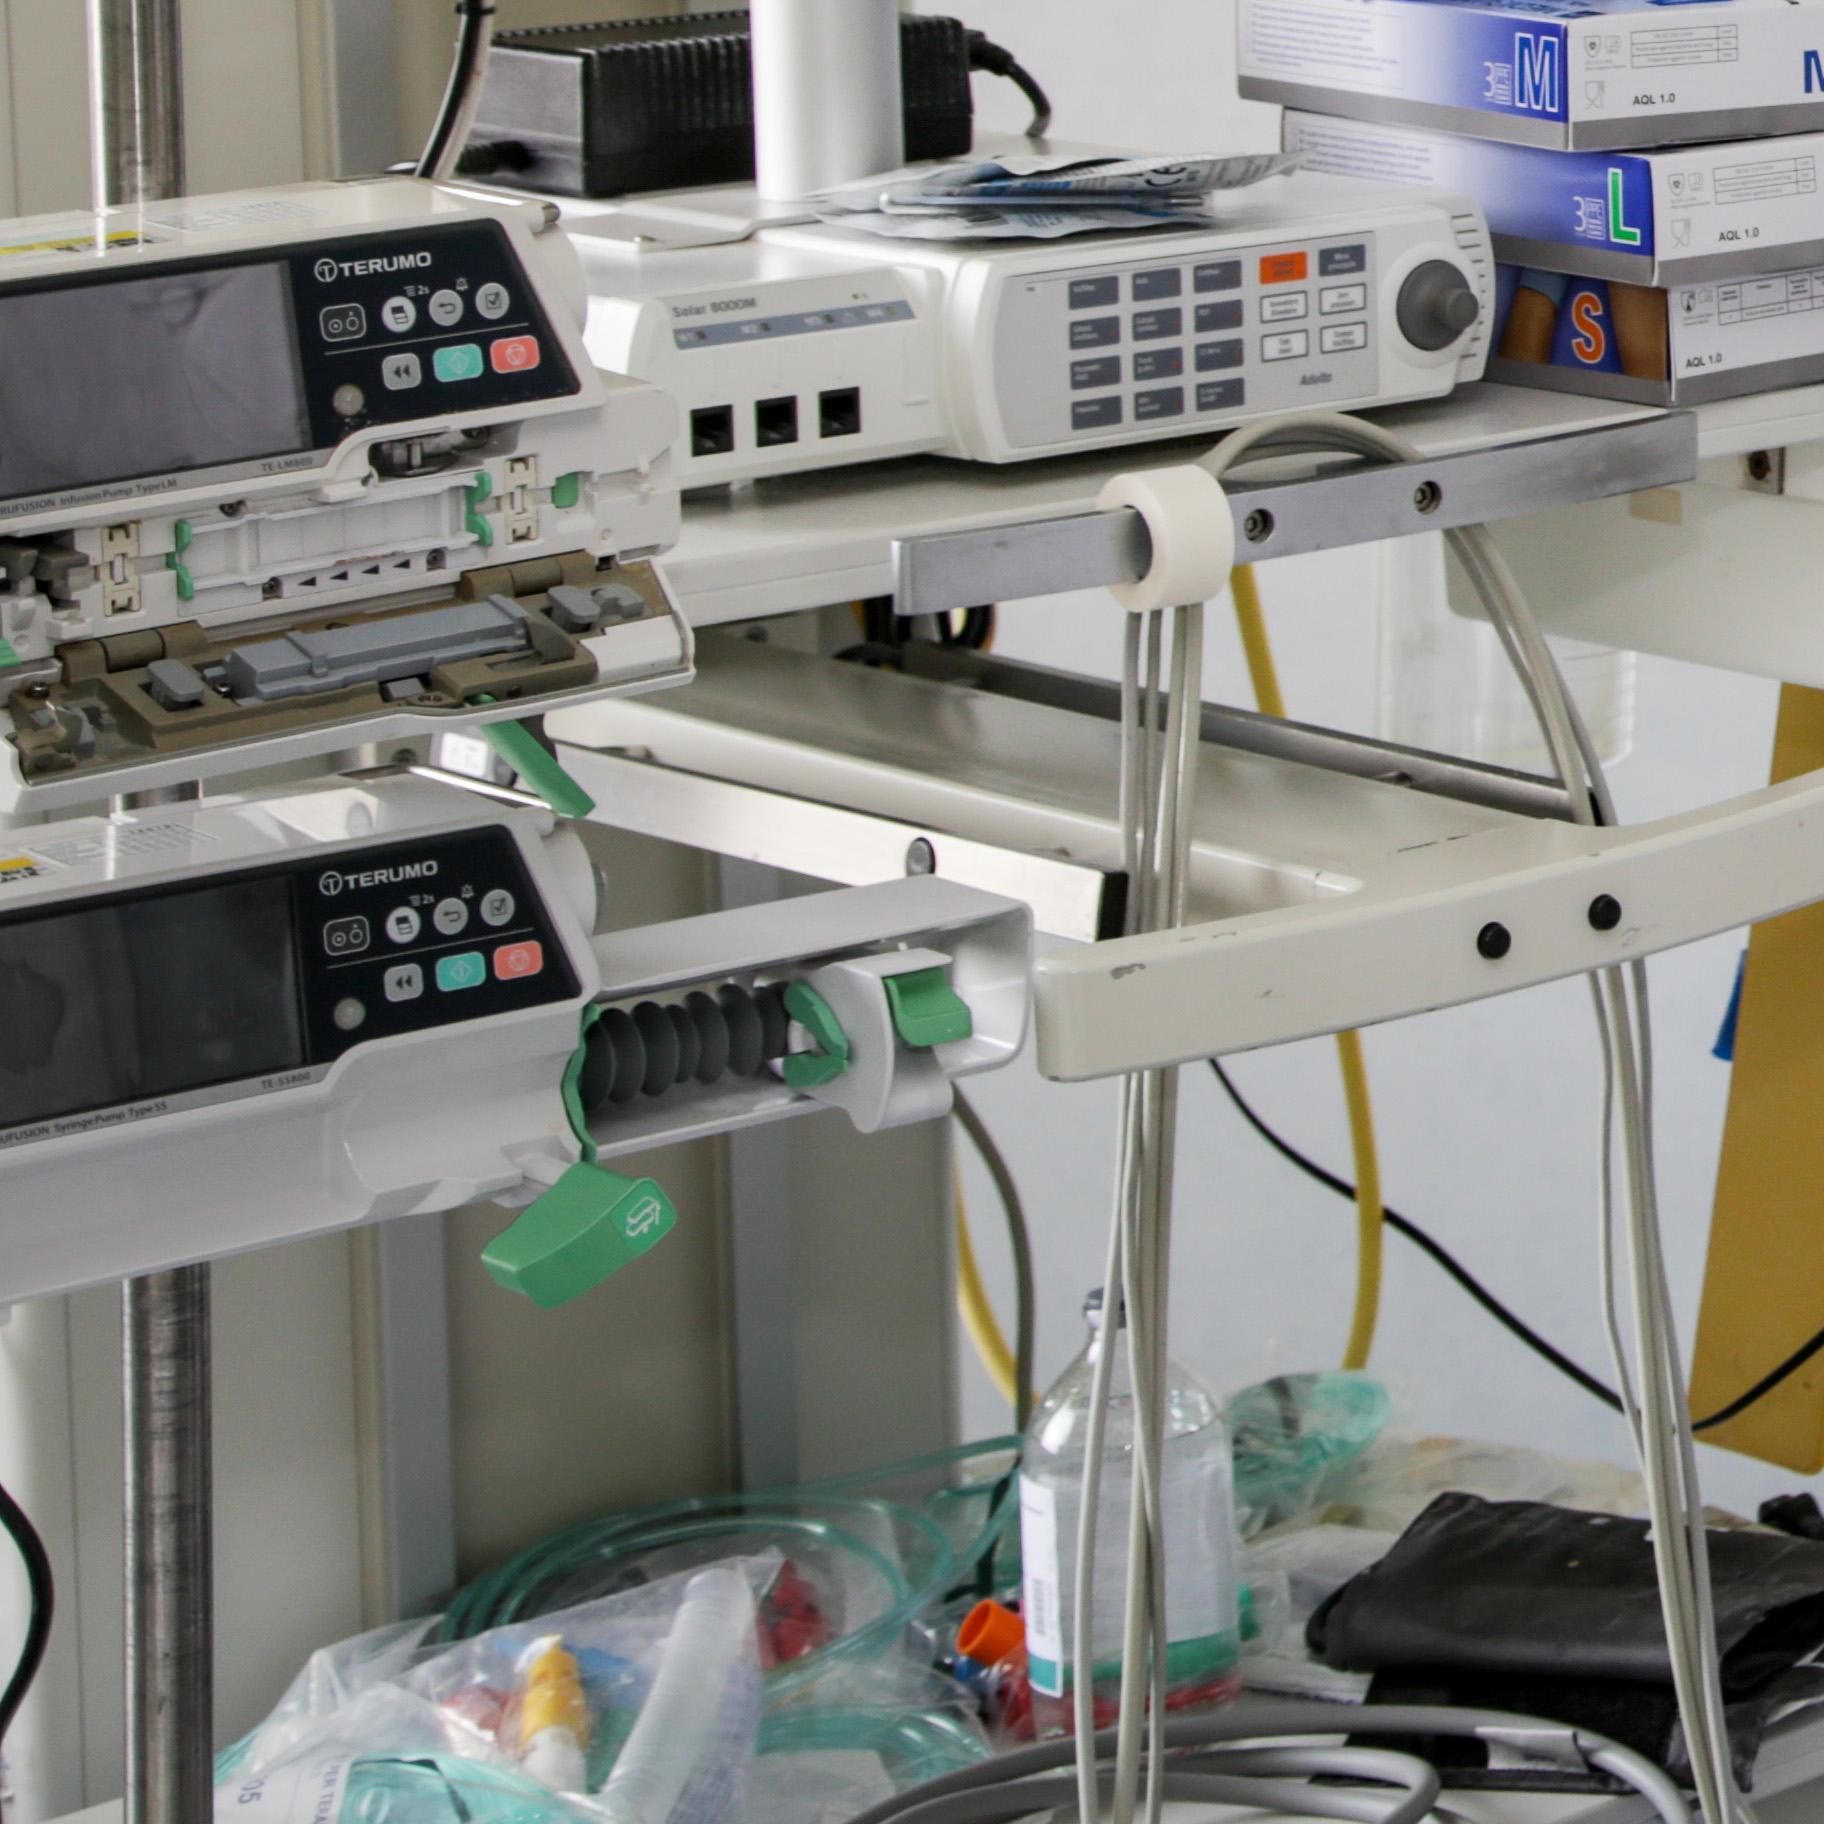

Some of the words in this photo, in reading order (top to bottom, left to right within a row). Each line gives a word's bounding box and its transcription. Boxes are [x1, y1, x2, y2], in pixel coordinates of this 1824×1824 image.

[1515, 32, 1560, 113] M
[1632, 94, 1657, 106] AQL
[1659, 93, 1676, 104] 1.0
[1607, 167, 1641, 247] L
[1718, 228, 1741, 242] AQL
[1744, 227, 1760, 240] 1.0
[339, 252, 432, 278] TERUMO
[417, 284, 430, 295] 2s
[672, 305, 707, 318] Solar
[1571, 291, 1606, 364] S
[1685, 356, 1707, 369] AQL
[1708, 353, 1723, 366] 1.0
[344, 860, 439, 889] TERUMO
[0, 1125, 50, 1144] UFUSION
